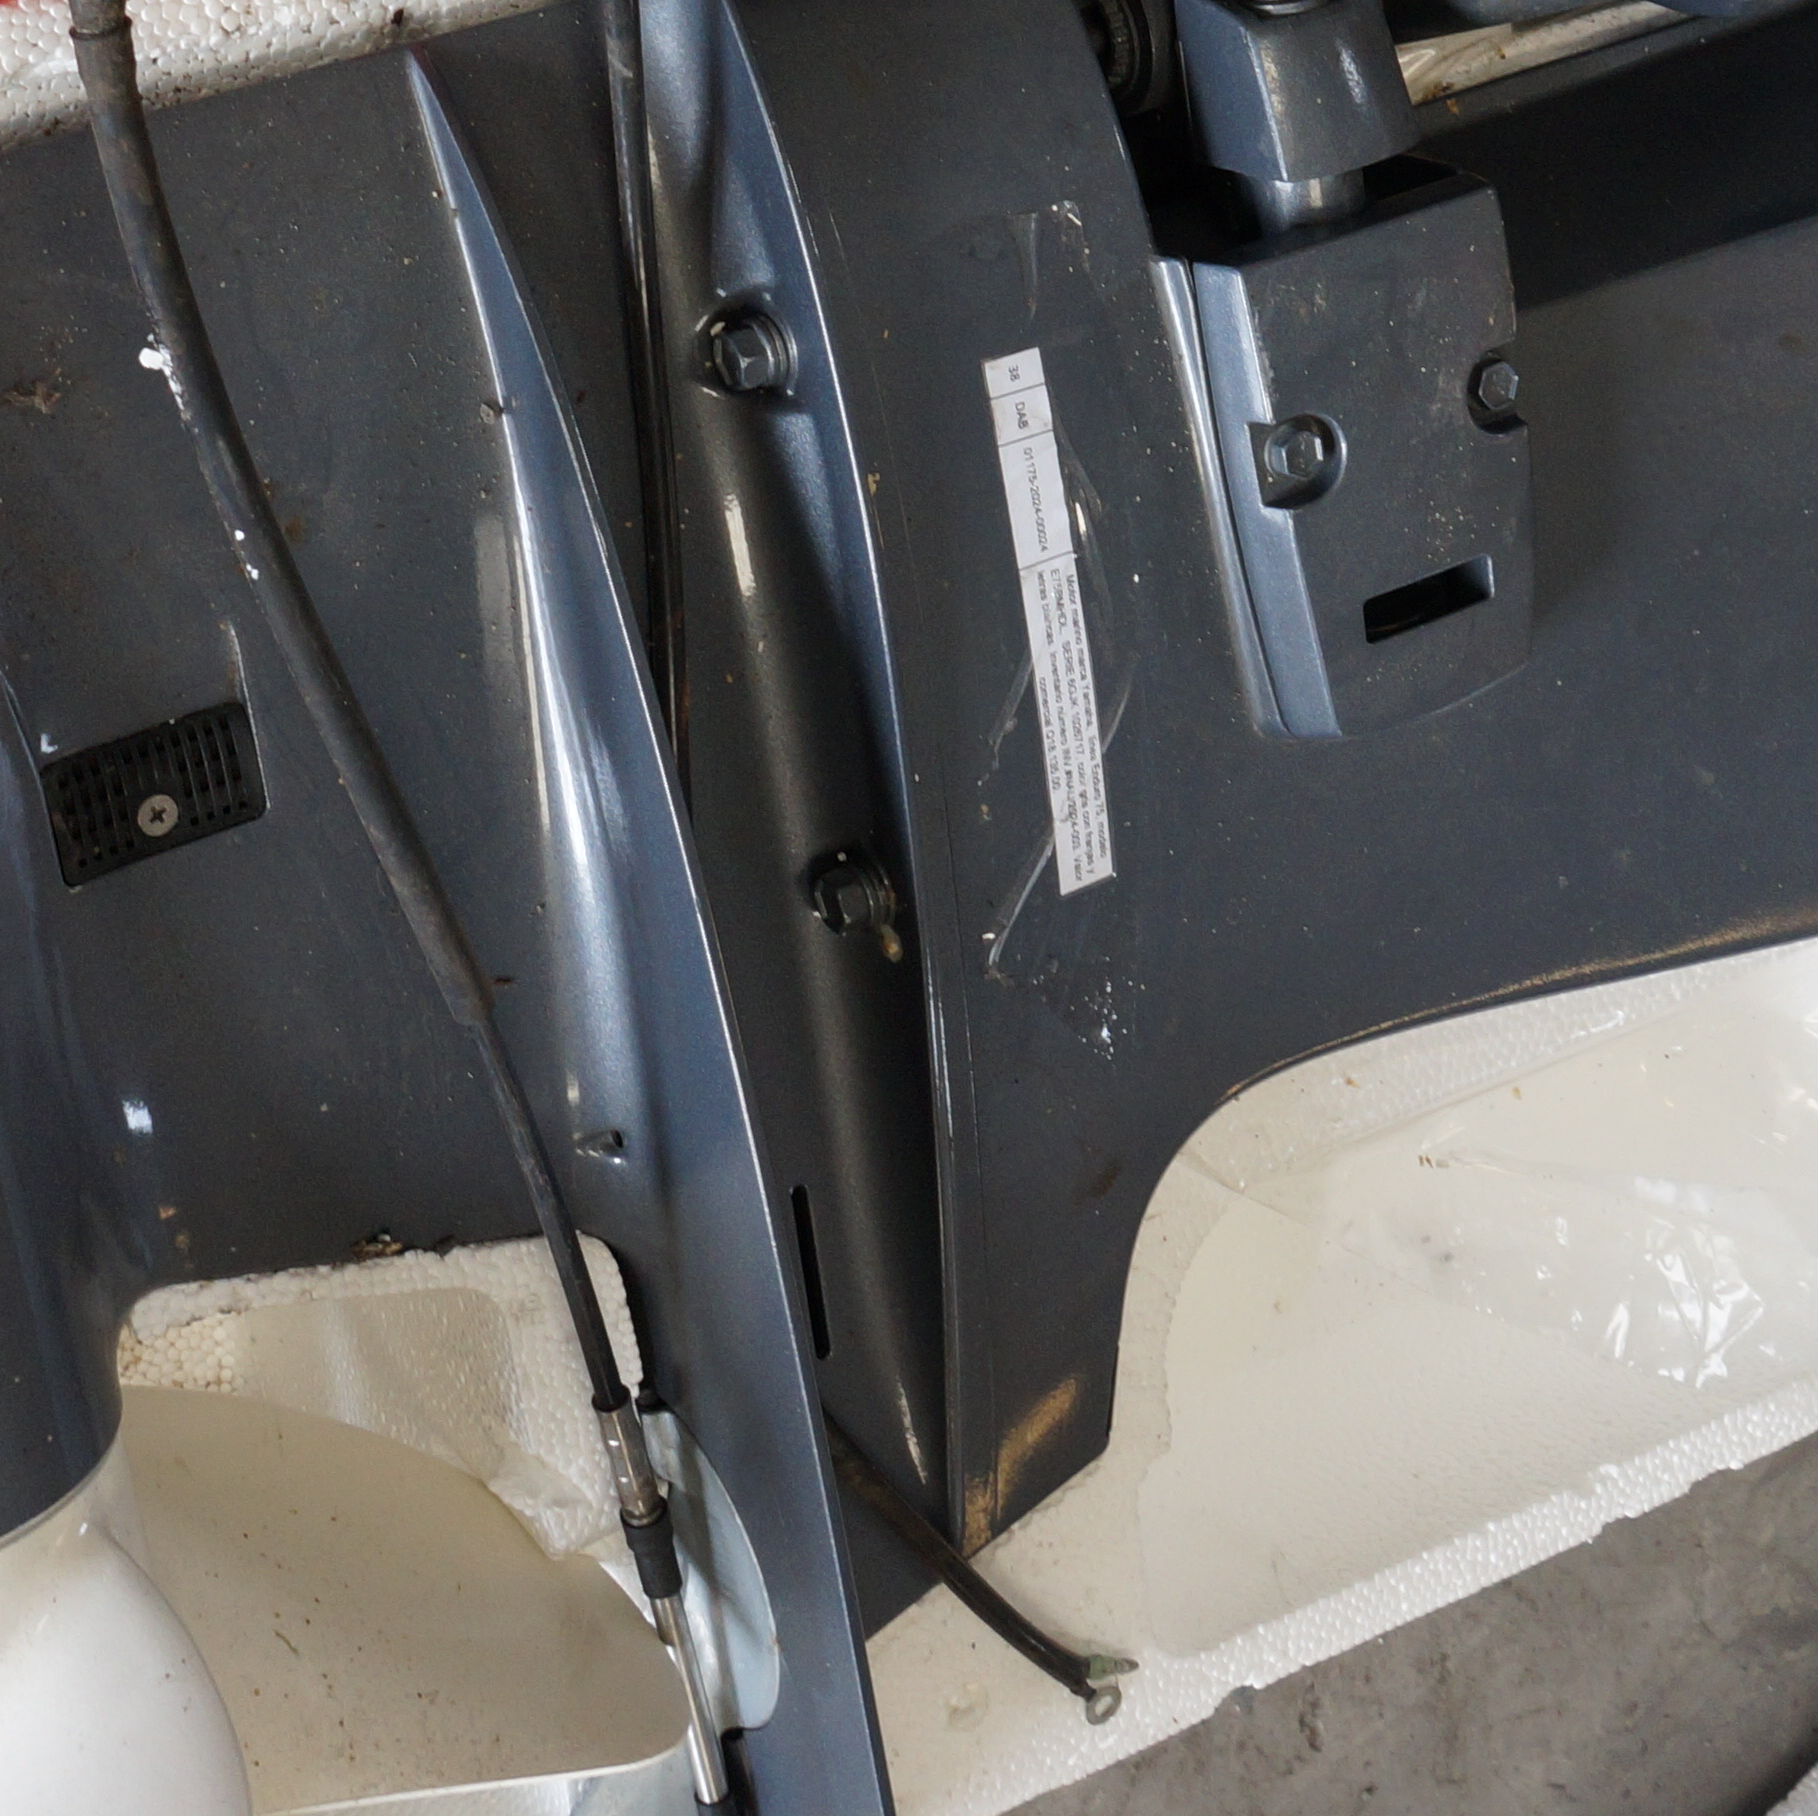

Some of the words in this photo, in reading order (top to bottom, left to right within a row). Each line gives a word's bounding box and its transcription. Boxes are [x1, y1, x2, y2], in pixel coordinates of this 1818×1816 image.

[1007, 364, 1020, 382] 38
[1014, 401, 1028, 430] DAB
[1066, 574, 1077, 605] Motor
[1076, 646, 1087, 681] marca
[1061, 639, 1075, 677] SERIE
